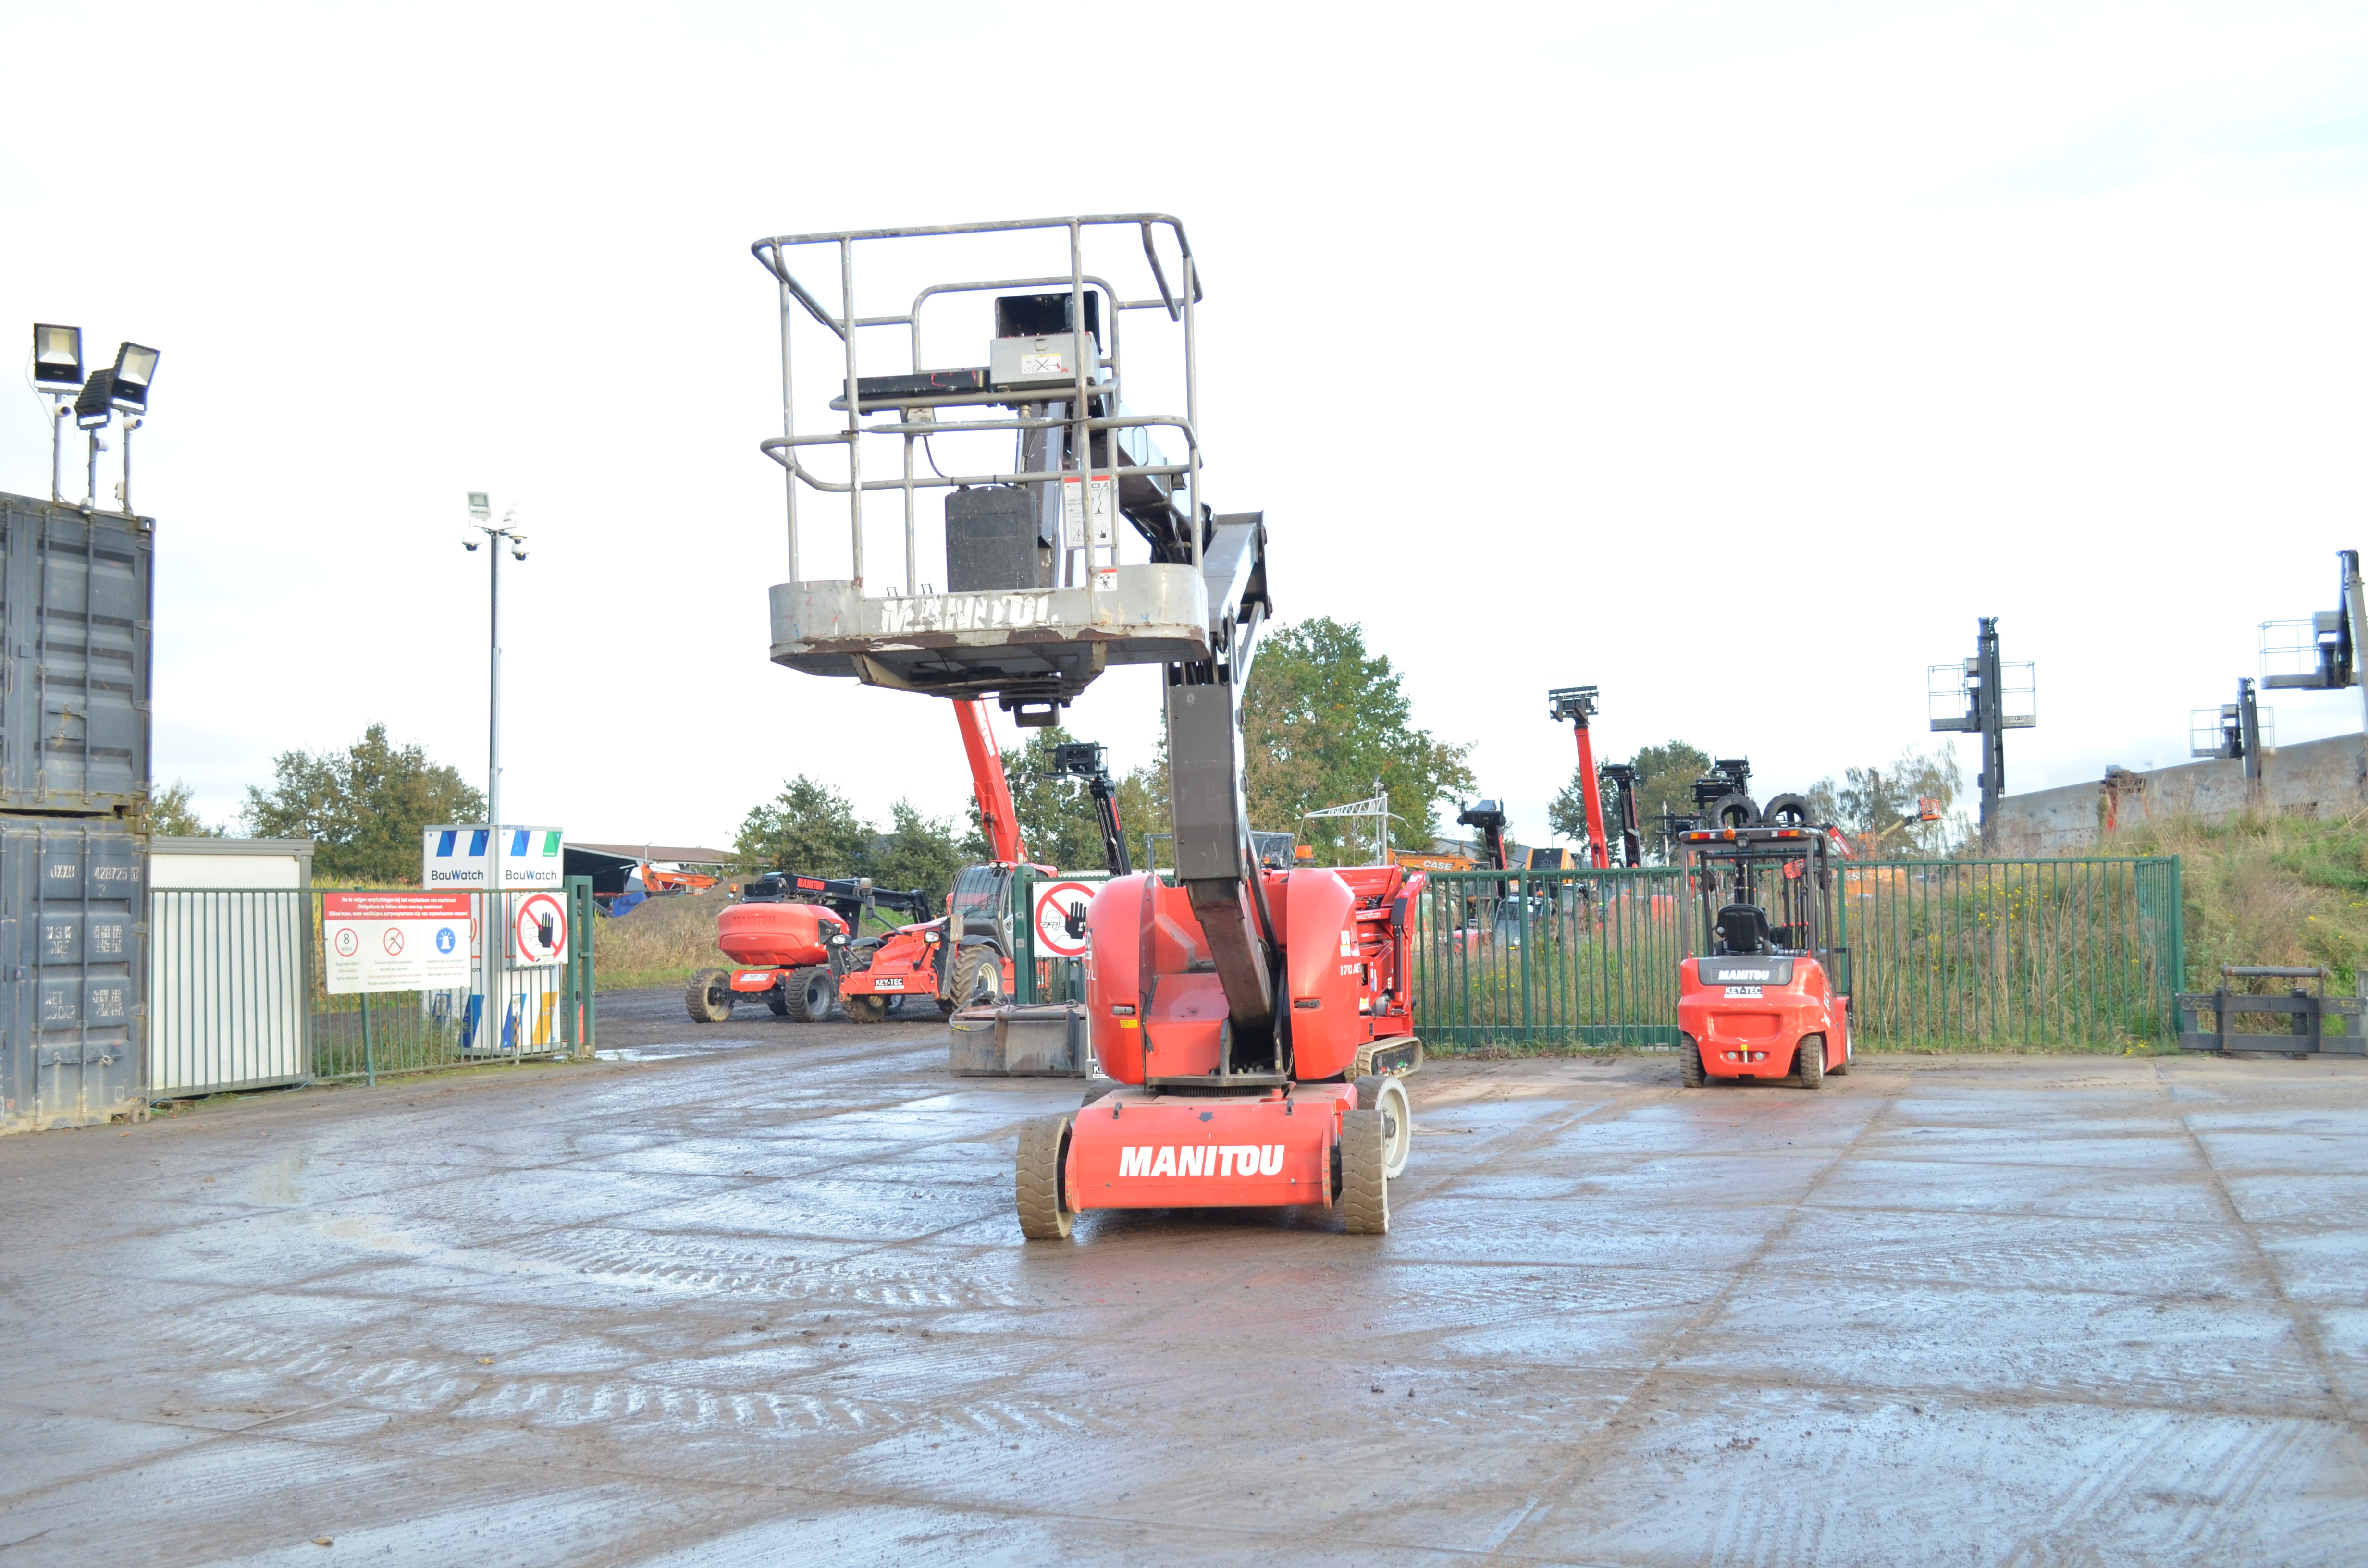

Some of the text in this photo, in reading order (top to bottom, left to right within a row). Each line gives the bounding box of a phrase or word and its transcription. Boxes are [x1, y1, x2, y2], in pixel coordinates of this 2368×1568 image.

[1423, 860, 1453, 870] CASE
[95, 867, 127, 880] 428725
[431, 870, 484, 880] BauWatch
[506, 870, 556, 880] BauWatch
[797, 877, 826, 891] MANITOU
[732, 915, 776, 927] MANITOU
[344, 933, 350, 944] 8
[1340, 965, 1352, 975] 170
[1718, 970, 1770, 980] MANITOU
[1725, 986, 1761, 994] KEY-TEC
[1119, 1145, 1285, 1176] MANITOU
